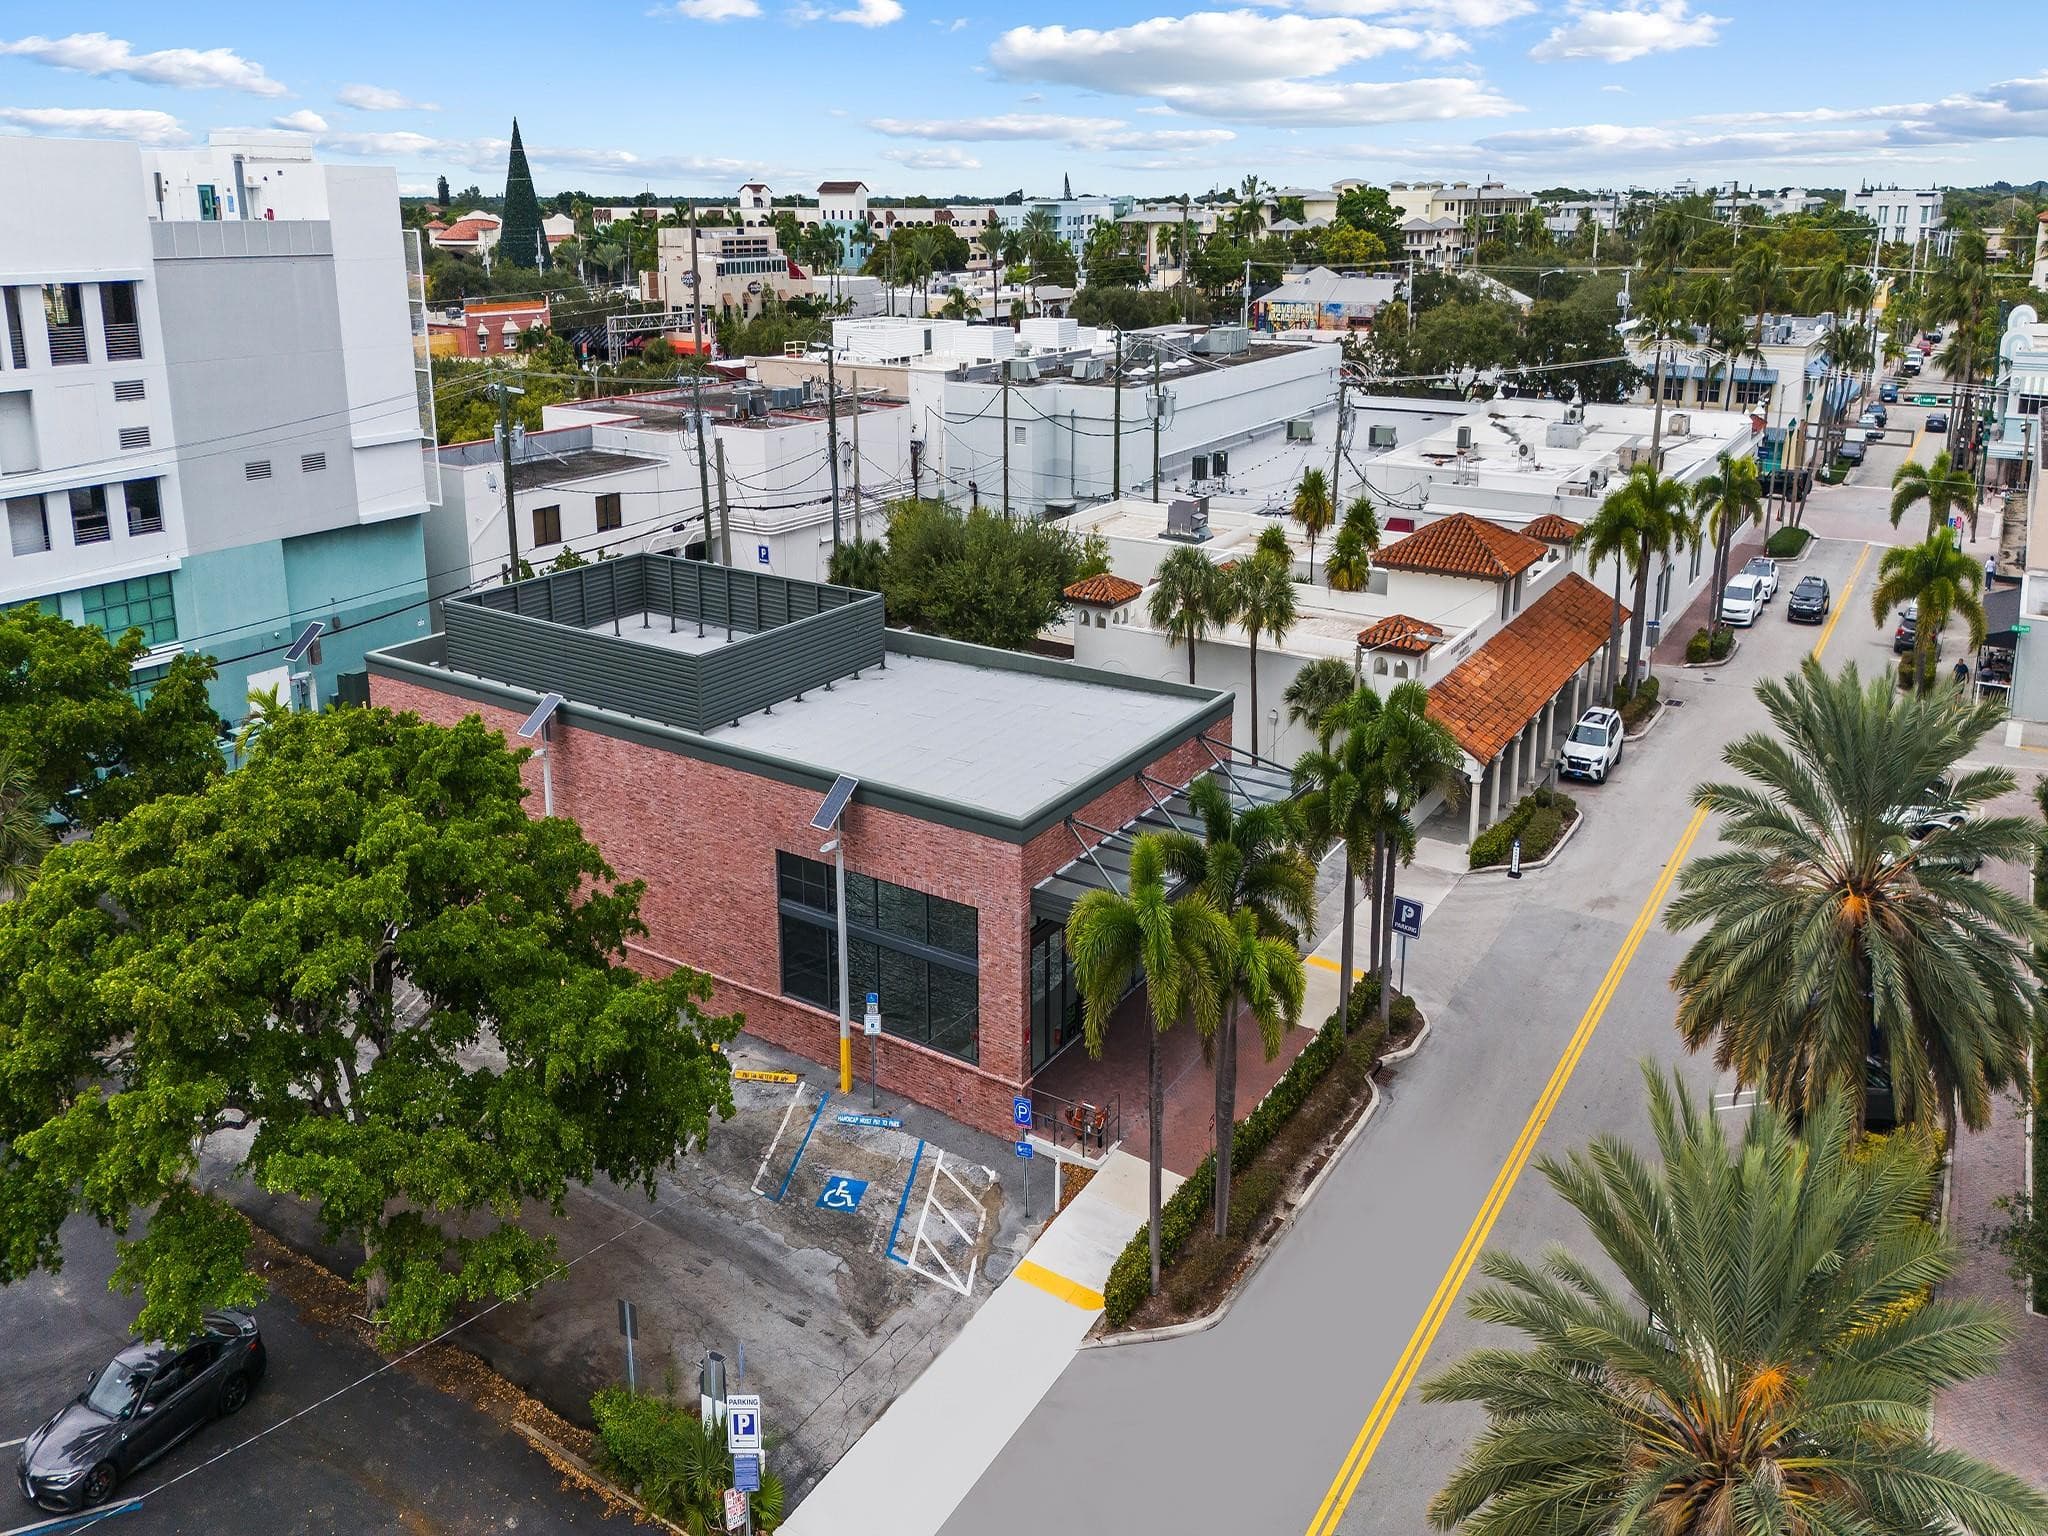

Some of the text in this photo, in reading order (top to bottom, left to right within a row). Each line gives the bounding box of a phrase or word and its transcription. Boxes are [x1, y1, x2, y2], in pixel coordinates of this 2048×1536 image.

[761, 548, 767, 558] P
[1401, 904, 1415, 922] P
[1394, 921, 1417, 934] PARKING
[1018, 1105, 1028, 1119] P
[837, 1115, 858, 1123] HANDICAP
[728, 1398, 758, 1406] PARKING
[738, 1414, 750, 1435] P
